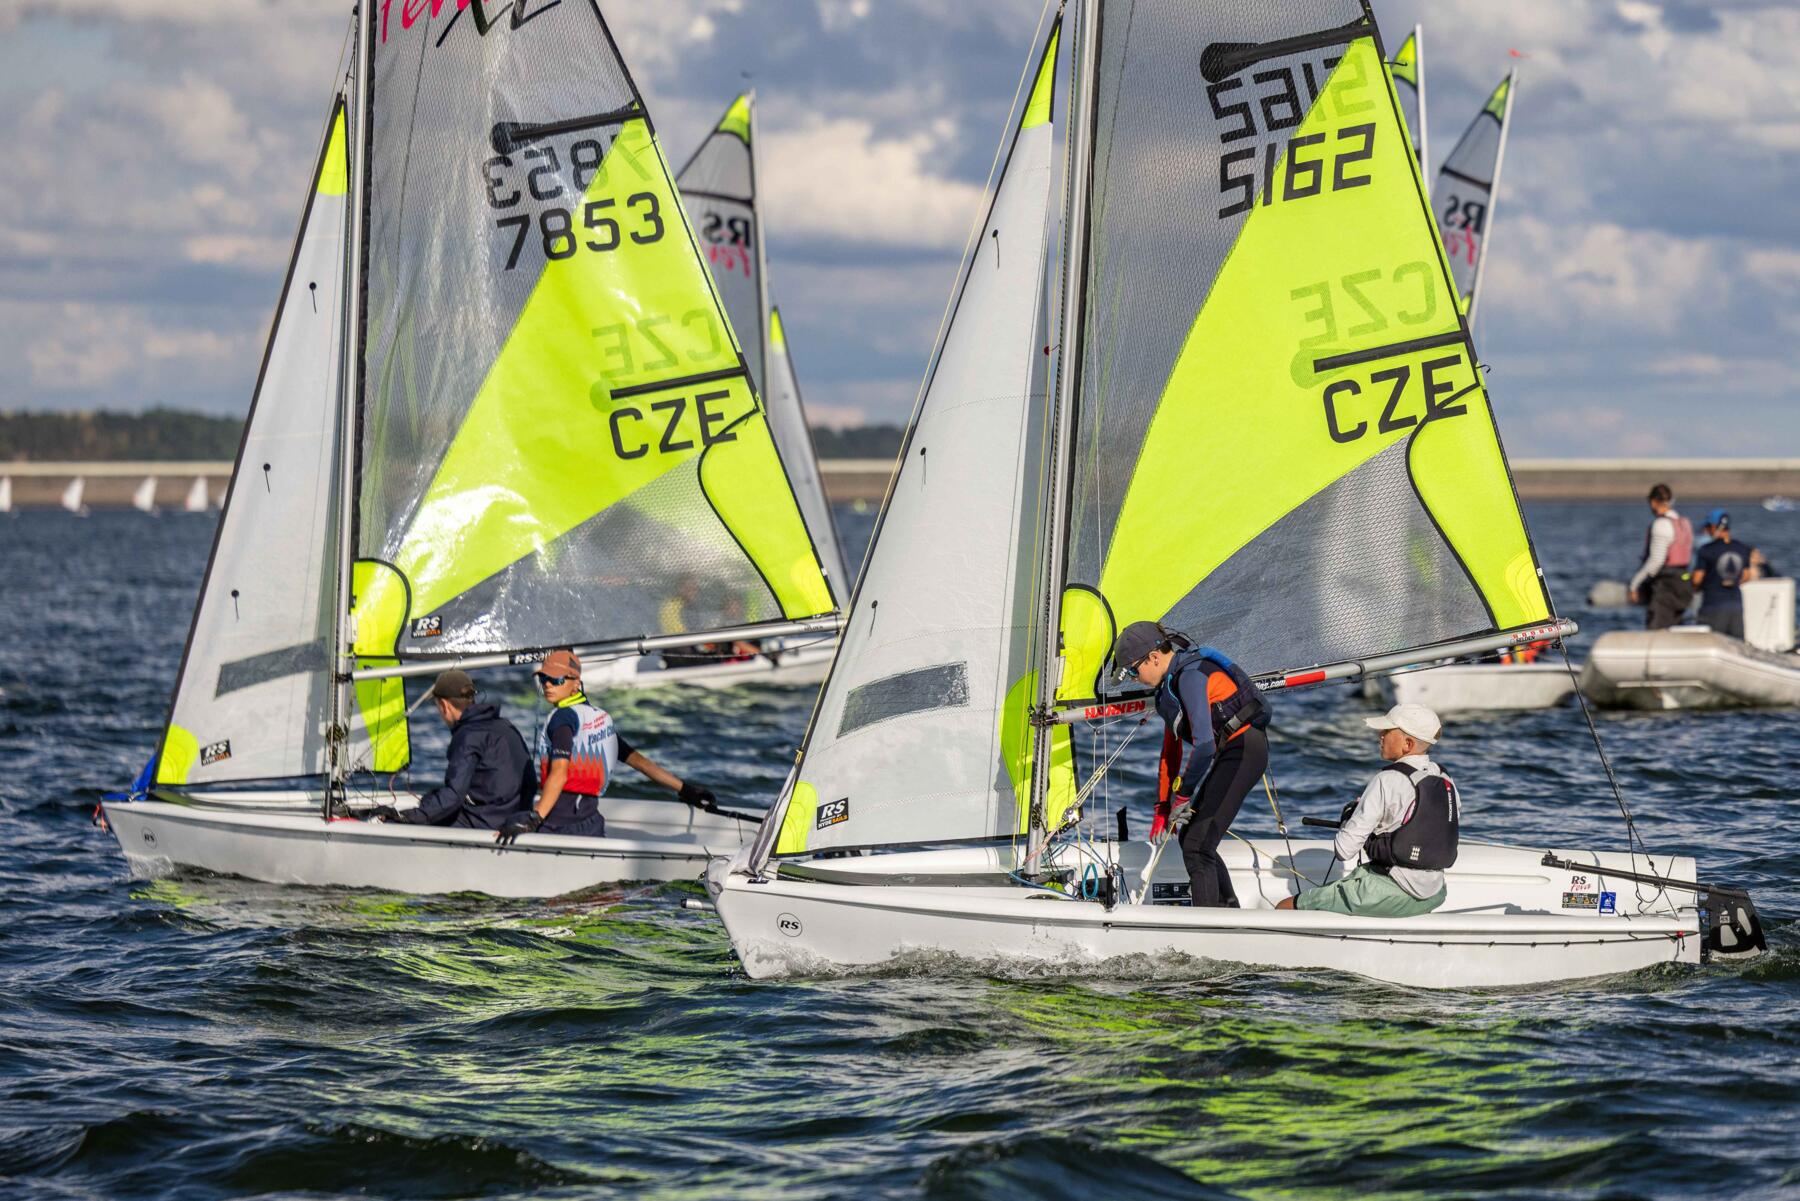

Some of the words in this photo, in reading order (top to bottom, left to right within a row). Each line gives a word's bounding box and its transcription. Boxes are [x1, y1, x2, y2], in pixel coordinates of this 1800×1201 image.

[1219, 122, 1377, 220] 5162
[496, 191, 665, 271] 7853
[1322, 353, 1468, 444] CZE
[608, 389, 738, 461] CZE
[416, 616, 441, 631] RS
[1084, 700, 1146, 720] HARKEN
[205, 740, 228, 758] RS
[821, 800, 846, 819] RS
[1571, 876, 1587, 885] RS
[780, 919, 800, 930] RS
